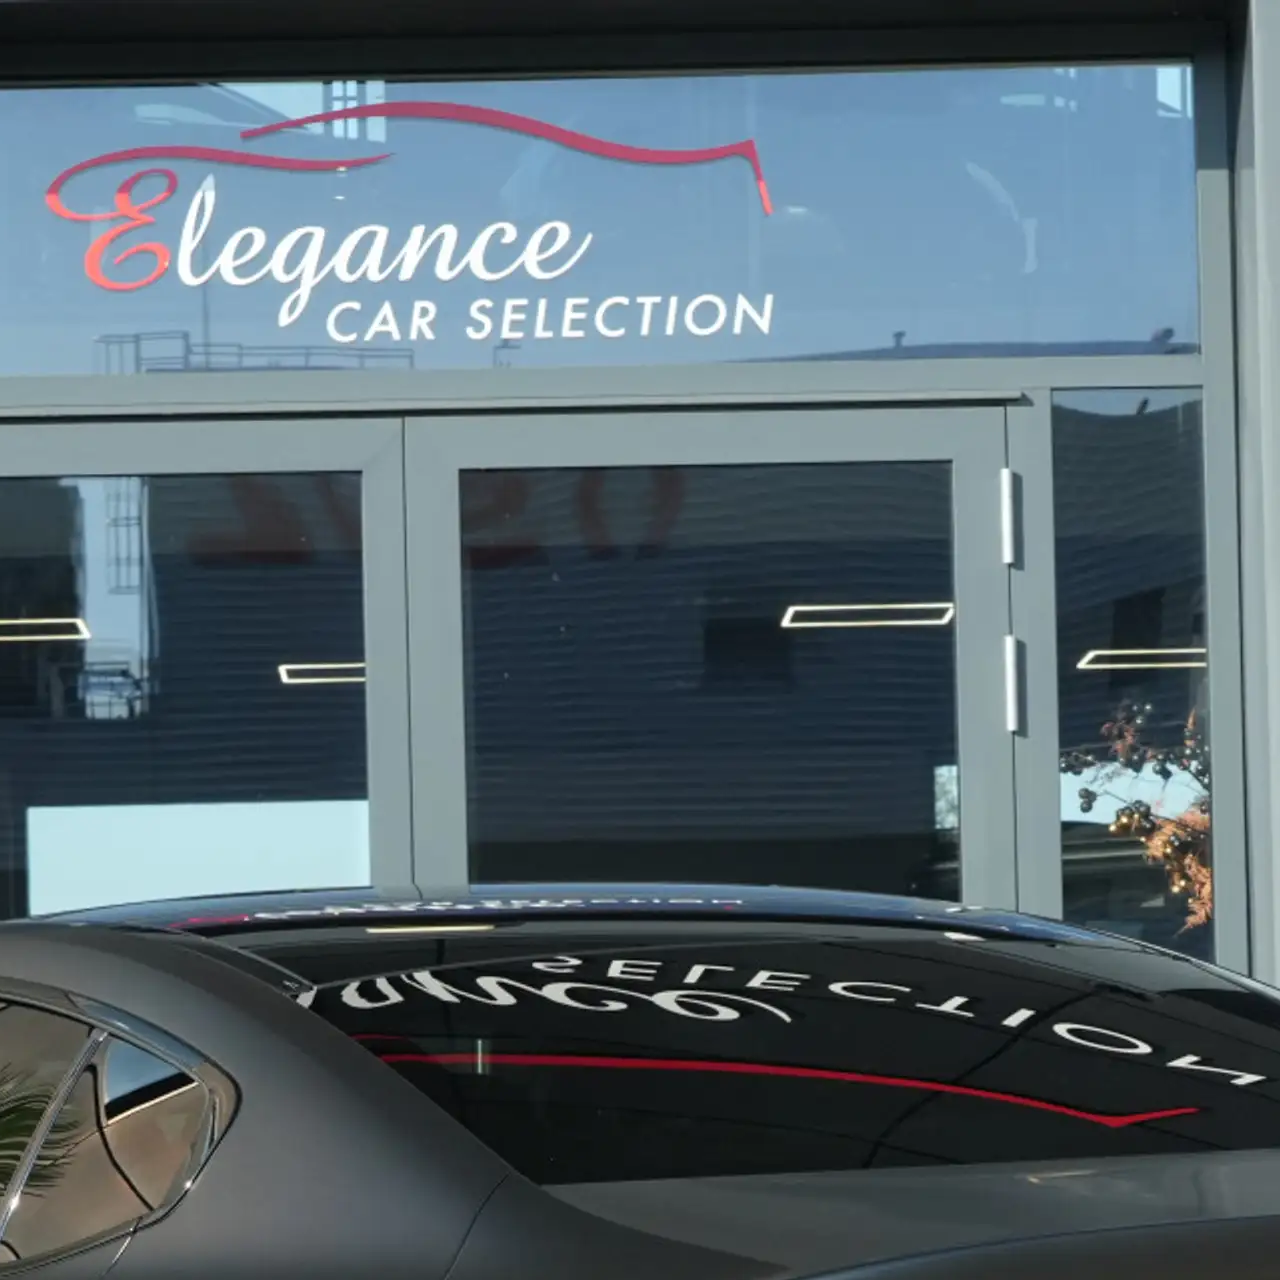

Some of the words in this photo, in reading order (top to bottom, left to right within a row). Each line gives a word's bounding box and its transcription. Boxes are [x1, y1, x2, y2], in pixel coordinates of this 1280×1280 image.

[45, 145, 594, 328] Elegance
[325, 298, 438, 343] CAR
[465, 292, 775, 341] SELECTION
